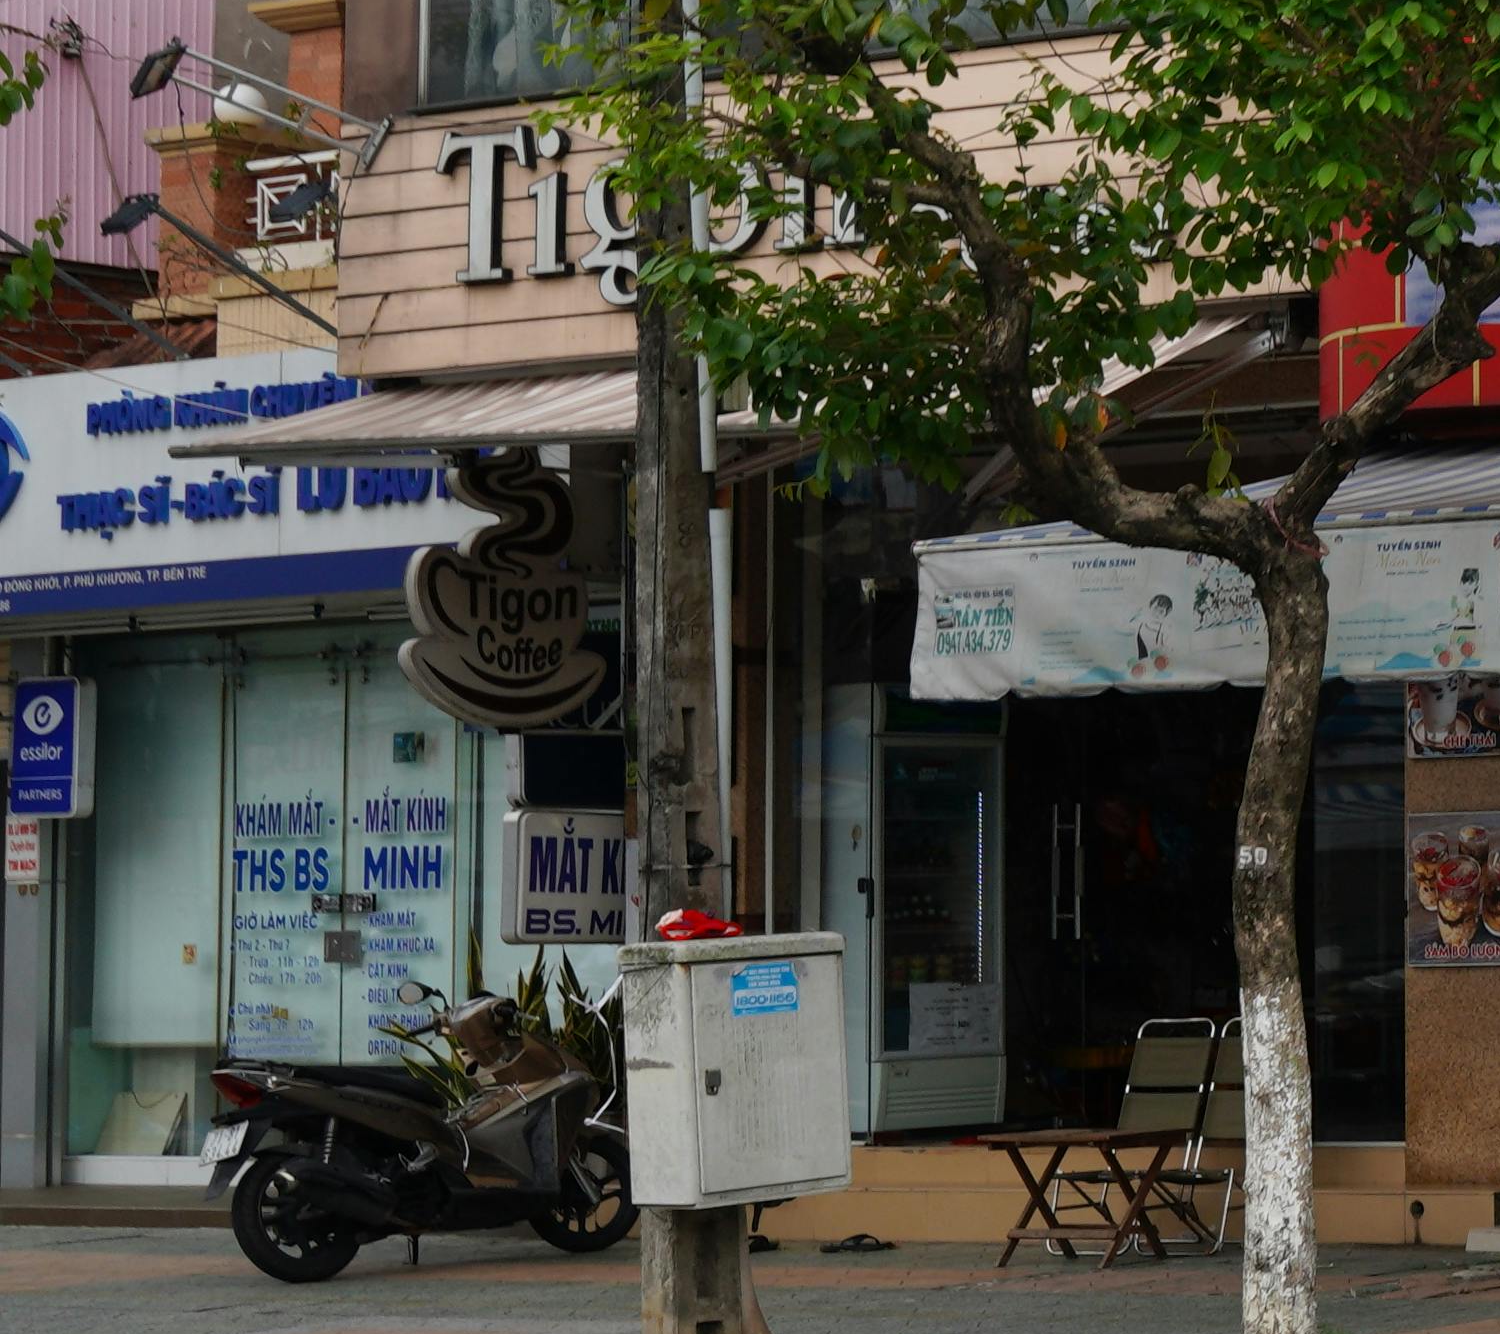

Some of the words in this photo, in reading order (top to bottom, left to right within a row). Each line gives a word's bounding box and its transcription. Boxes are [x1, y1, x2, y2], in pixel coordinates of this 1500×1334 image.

[87, 389, 171, 436] PHÒNG
[1415, 540, 1441, 551] SINH
[1110, 558, 1136, 568] SINH
[457, 569, 577, 634] Tigon
[478, 625, 562, 673] Coffee
[20, 741, 63, 763] essilor
[18, 787, 63, 802] PARTNERS
[236, 793, 282, 838] KHÁM
[288, 788, 324, 836] MẮT
[365, 785, 401, 833] MẮT
[407, 788, 446, 833] KÍNH
[233, 847, 286, 892] THS
[295, 846, 329, 891] BS
[363, 845, 443, 890] MINH
[529, 817, 594, 894] MẮT
[1240, 845, 1268, 869] 50
[261, 910, 286, 929] LÀM
[526, 909, 582, 936] BS.
